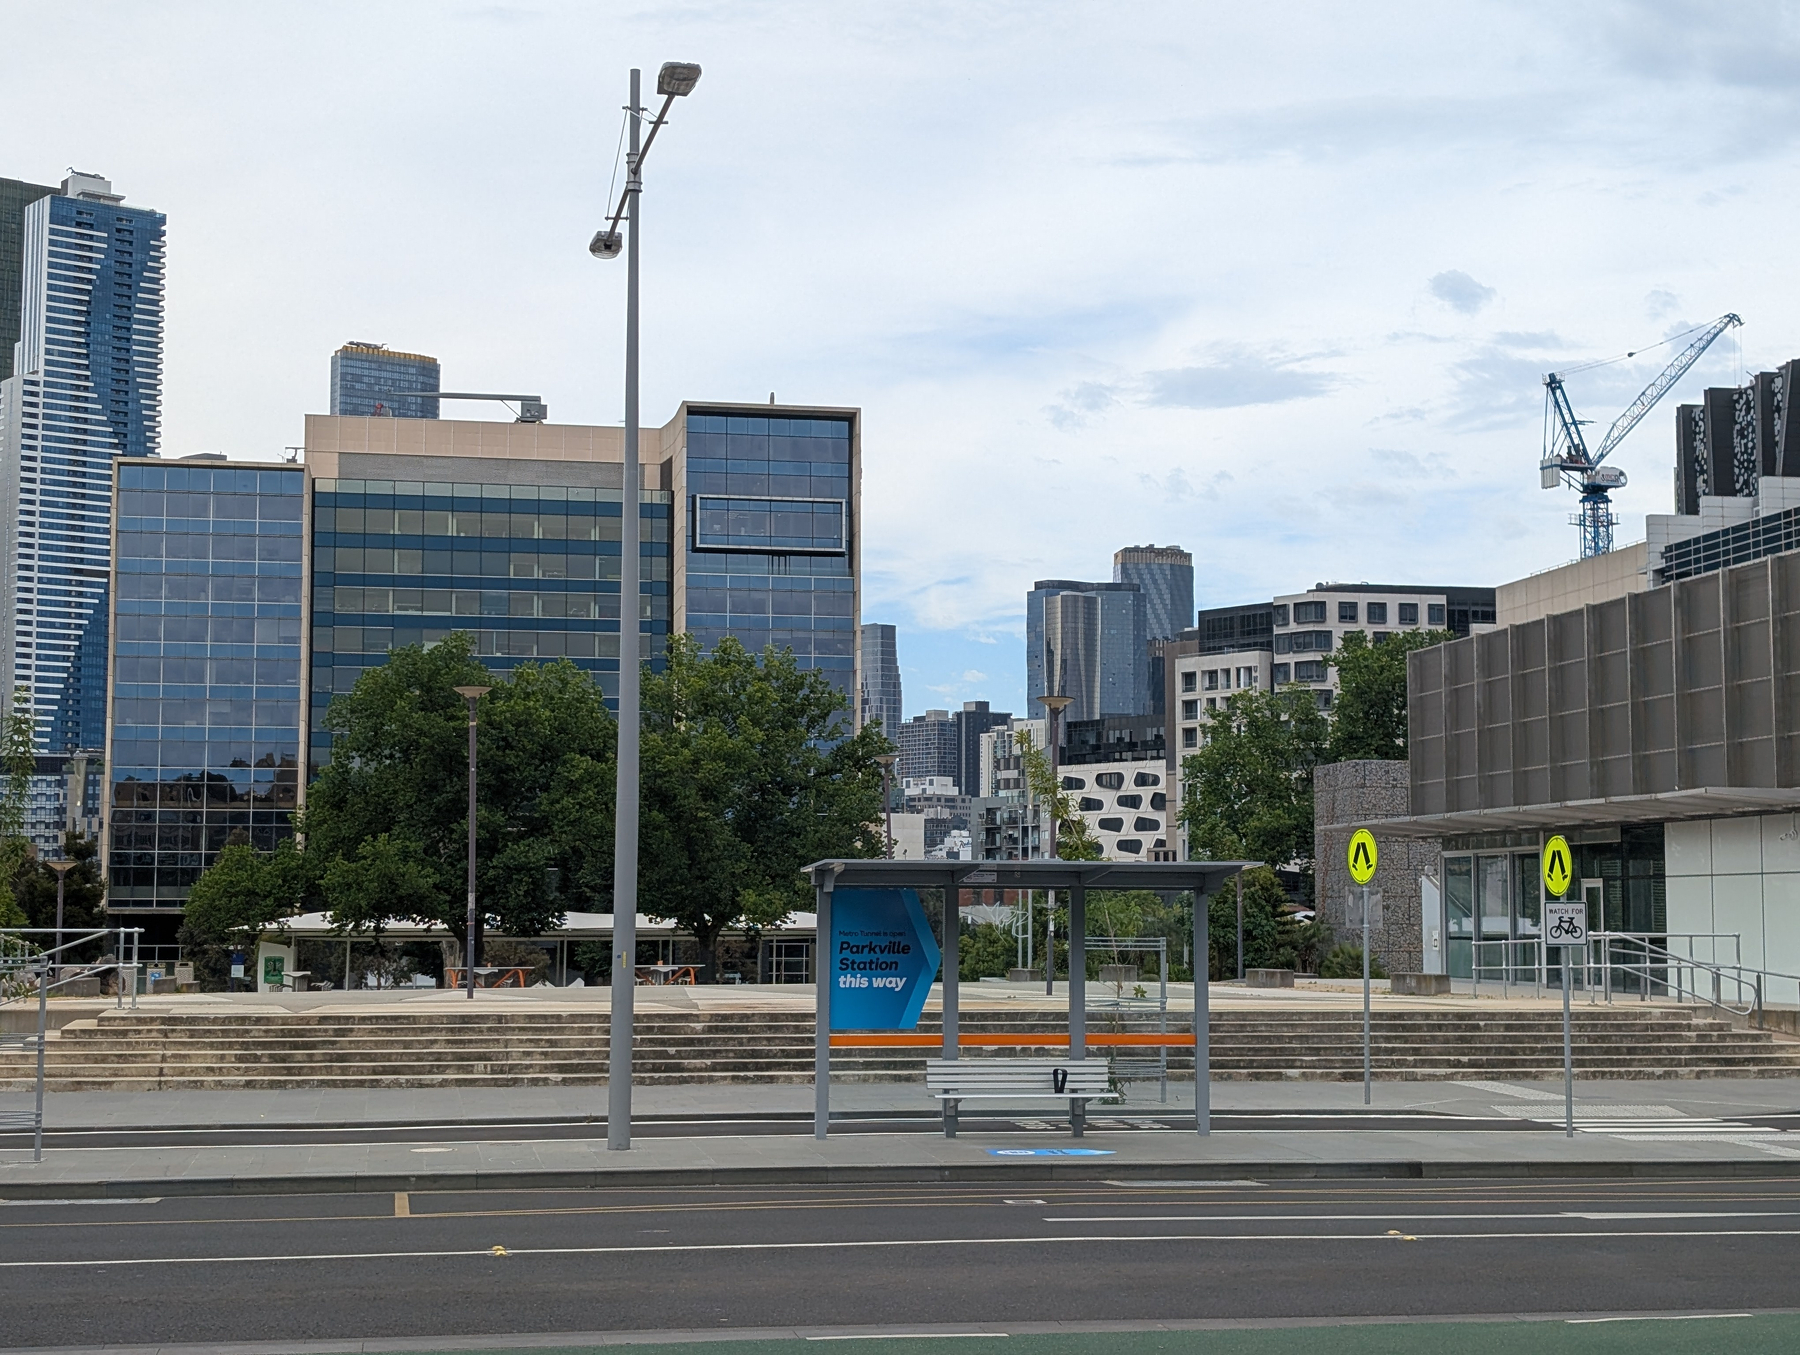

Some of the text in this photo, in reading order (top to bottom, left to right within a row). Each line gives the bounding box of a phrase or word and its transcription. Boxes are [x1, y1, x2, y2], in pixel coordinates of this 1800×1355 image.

[839, 941, 911, 955] Parkville
[838, 957, 899, 971] Station
[838, 973, 907, 991] this way
